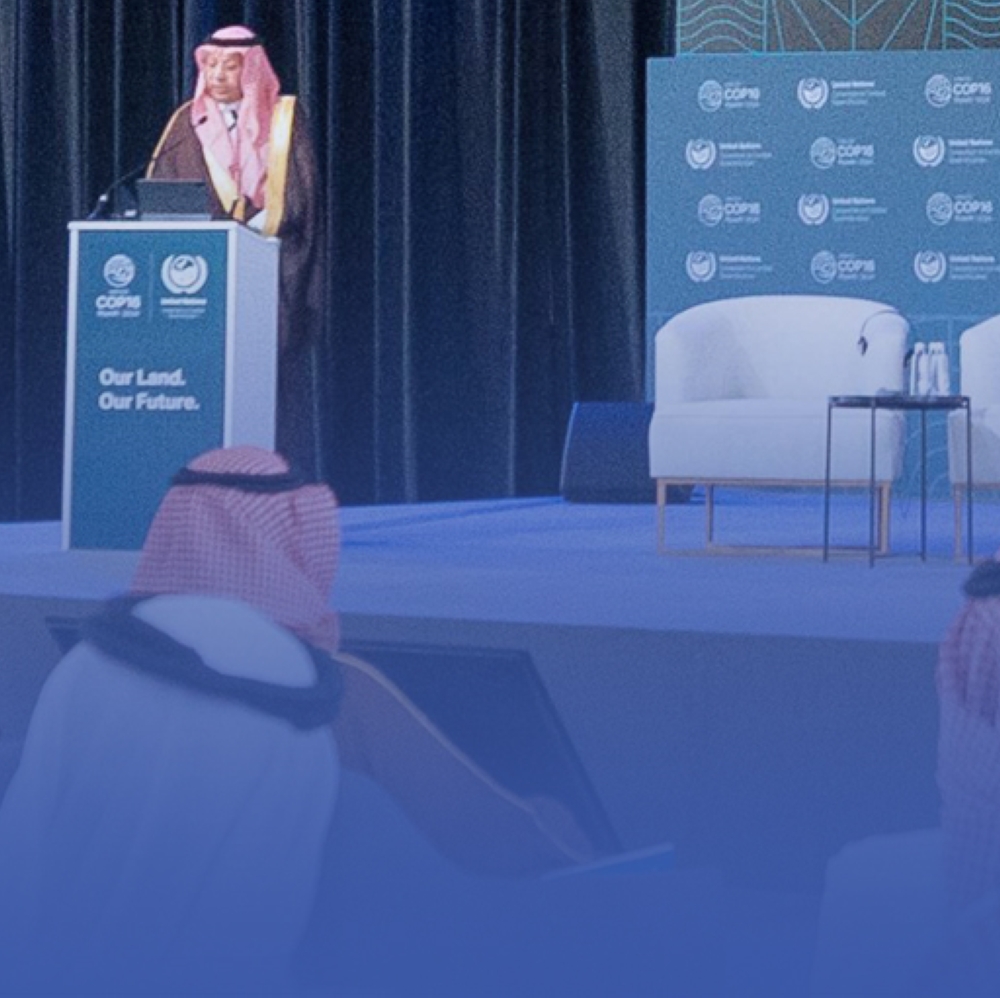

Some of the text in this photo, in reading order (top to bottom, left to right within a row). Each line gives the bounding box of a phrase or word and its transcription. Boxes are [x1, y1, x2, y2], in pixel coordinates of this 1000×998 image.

[99, 367, 186, 386] Our Land.
[98, 391, 200, 410] Our Future.
